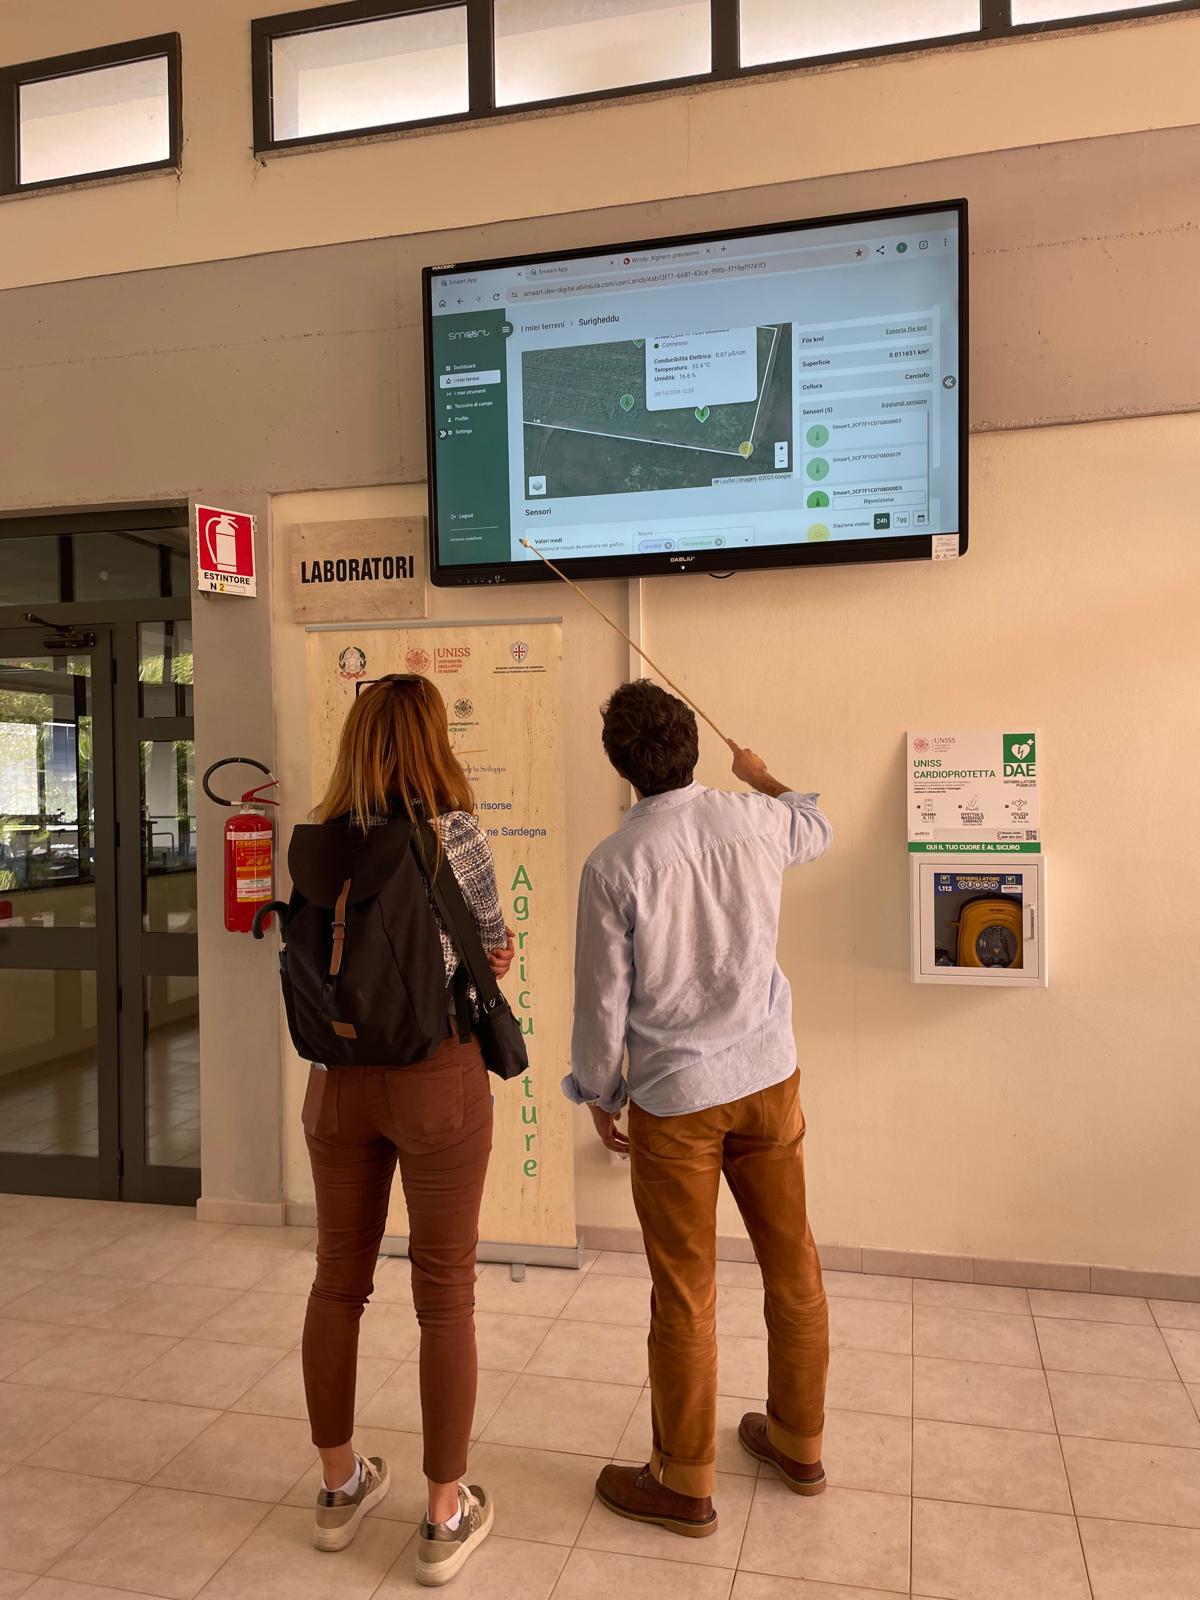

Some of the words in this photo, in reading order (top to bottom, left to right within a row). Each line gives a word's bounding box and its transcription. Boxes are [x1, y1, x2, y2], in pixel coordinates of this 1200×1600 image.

[578, 314, 620, 326] Surigheddu
[525, 324, 540, 332] miei
[542, 322, 565, 330] terreni
[802, 359, 830, 368] Superficie
[525, 508, 552, 516] Sensori
[301, 556, 414, 584] LABORATORI
[204, 572, 250, 585] ESTINTORE
[210, 582, 217, 590] N
[219, 583, 224, 591] 2
[438, 648, 471, 658] UNISS
[913, 770, 996, 778] CARDIOPROTETTA
[1003, 764, 1036, 777] DAE
[501, 826, 546, 838] Sardegna
[510, 864, 538, 1178] Agricuture
